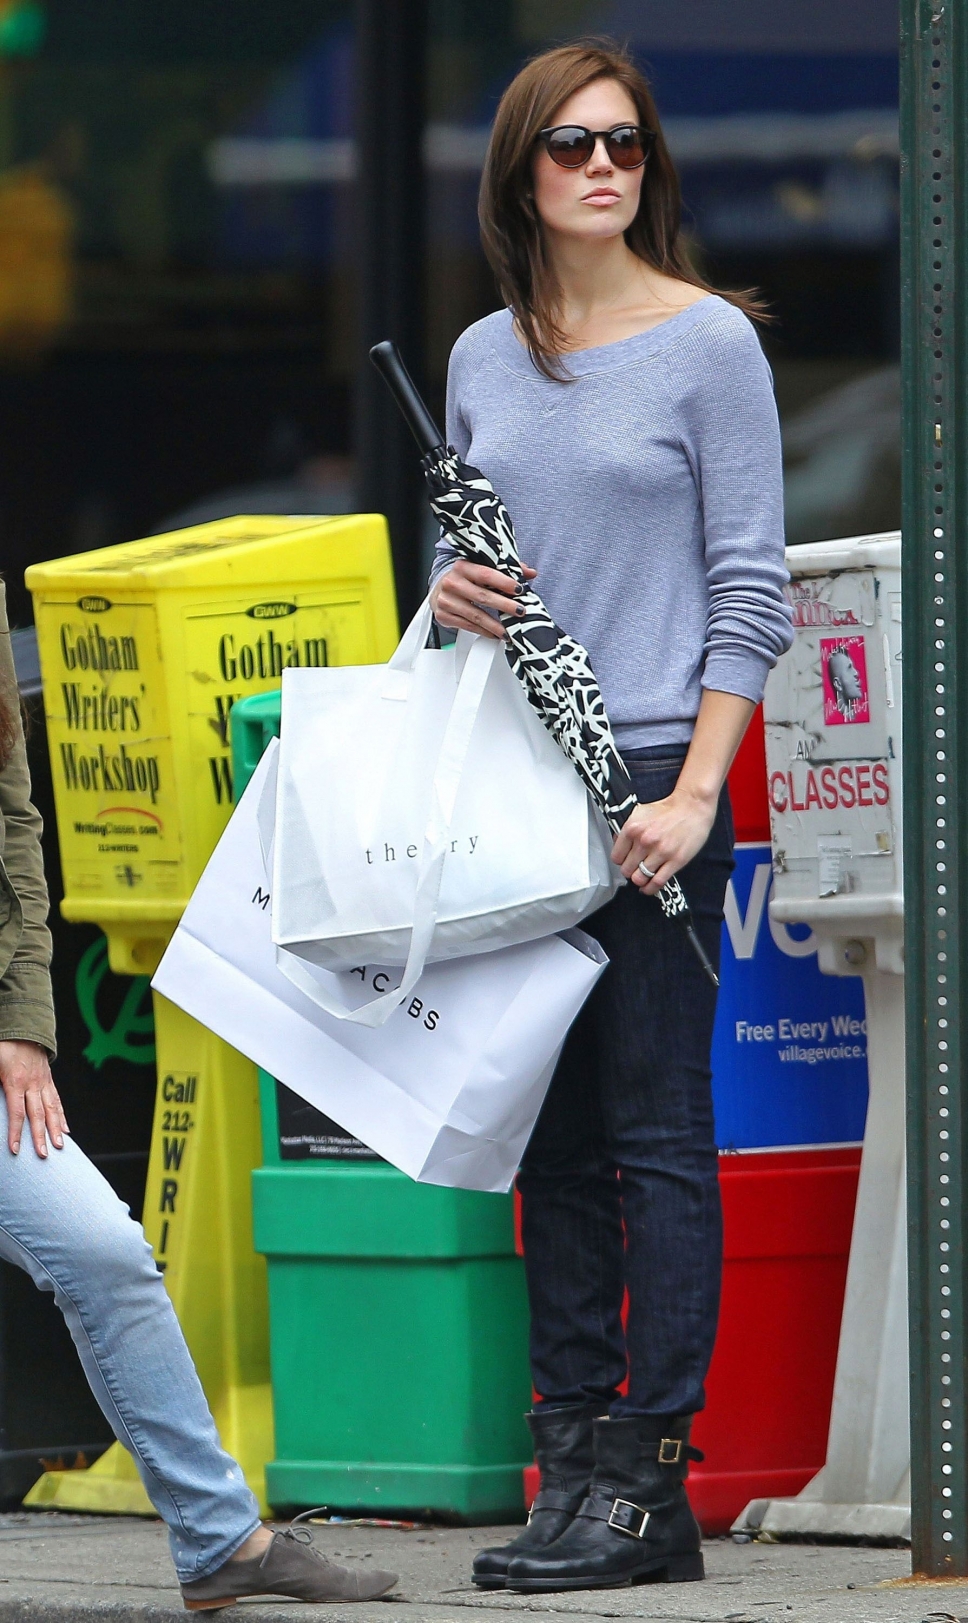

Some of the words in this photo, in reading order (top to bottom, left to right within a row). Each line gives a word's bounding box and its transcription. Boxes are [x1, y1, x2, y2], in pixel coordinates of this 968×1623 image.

[253, 603, 289, 617] GWW
[60, 622, 139, 671] Gotham
[218, 629, 329, 682] Gotham
[61, 682, 146, 733] Writers'
[60, 743, 160, 804] Workshop
[768, 763, 890, 813] CLASSES
[365, 835, 479, 865] thery
[349, 964, 440, 1031] ACBS
[735, 1020, 774, 1042] Free
[778, 1018, 828, 1042] Every
[778, 1042, 867, 1065] villagevoice.
[162, 1074, 196, 1103] Call
[162, 1110, 194, 1132] 212-
